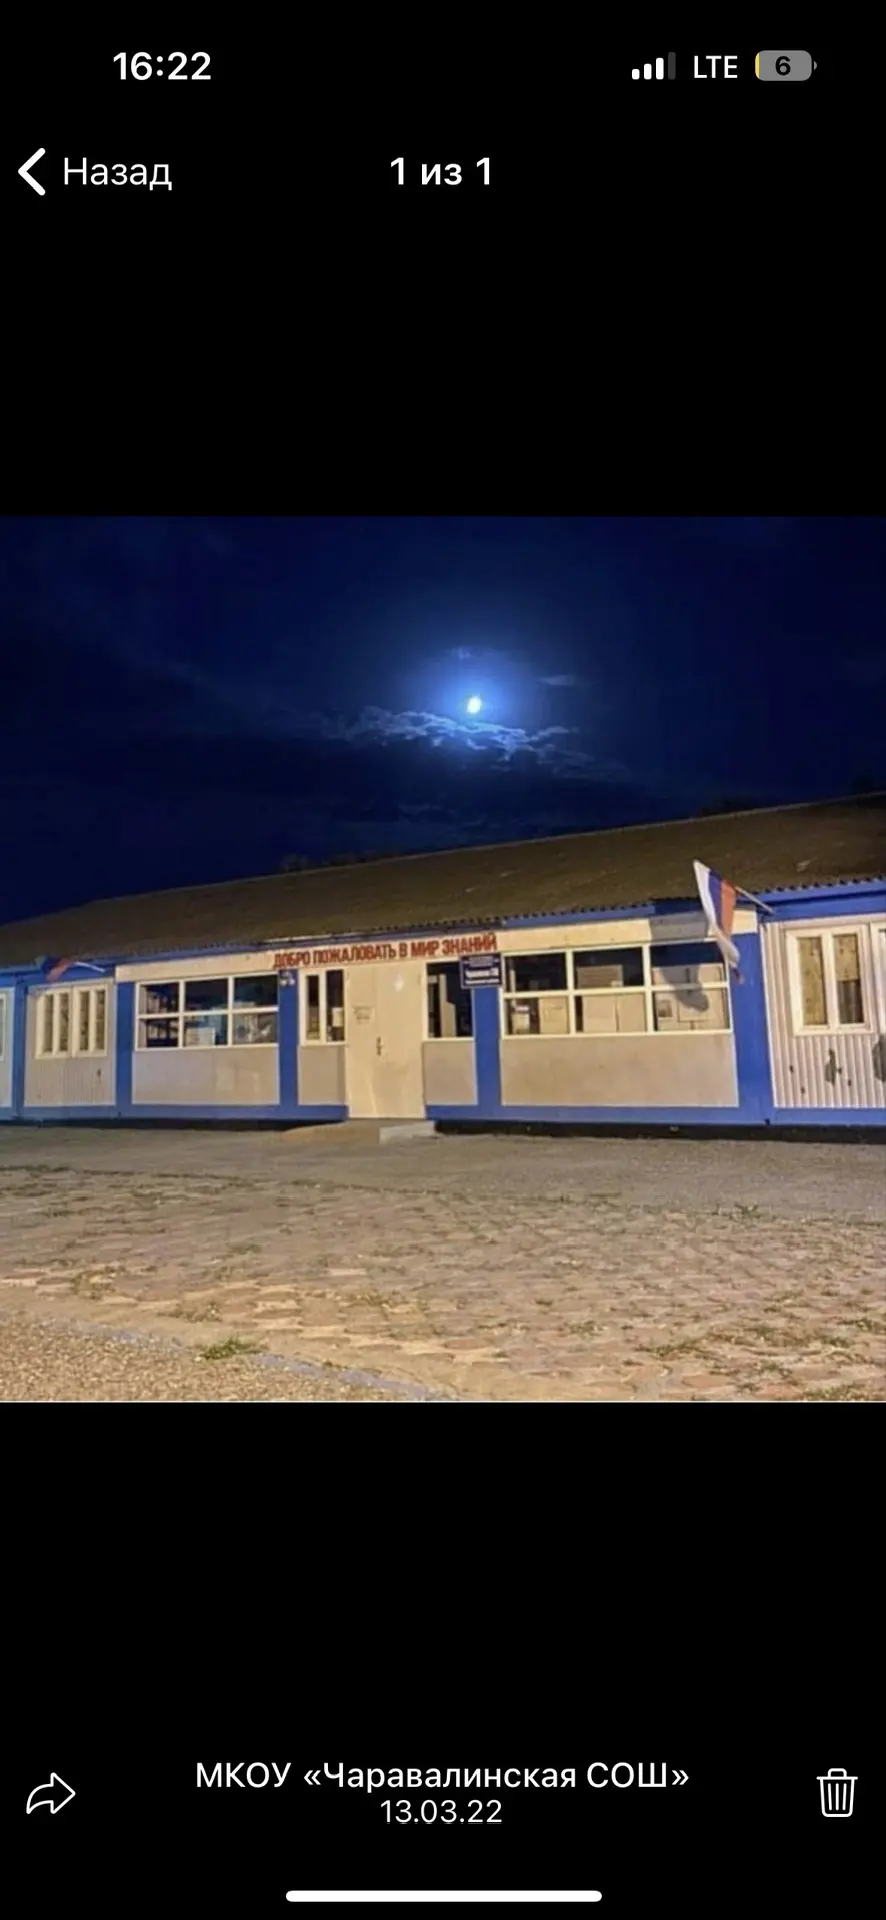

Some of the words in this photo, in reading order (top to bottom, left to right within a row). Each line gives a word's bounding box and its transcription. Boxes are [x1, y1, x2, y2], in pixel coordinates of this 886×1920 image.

[273, 952, 310, 968] ДОБРО
[313, 944, 396, 965] ПОЖАЛОВАТЬ
[399, 943, 408, 958] В
[411, 940, 440, 958] МИР
[442, 932, 498, 954] ЗНАНИЙ
